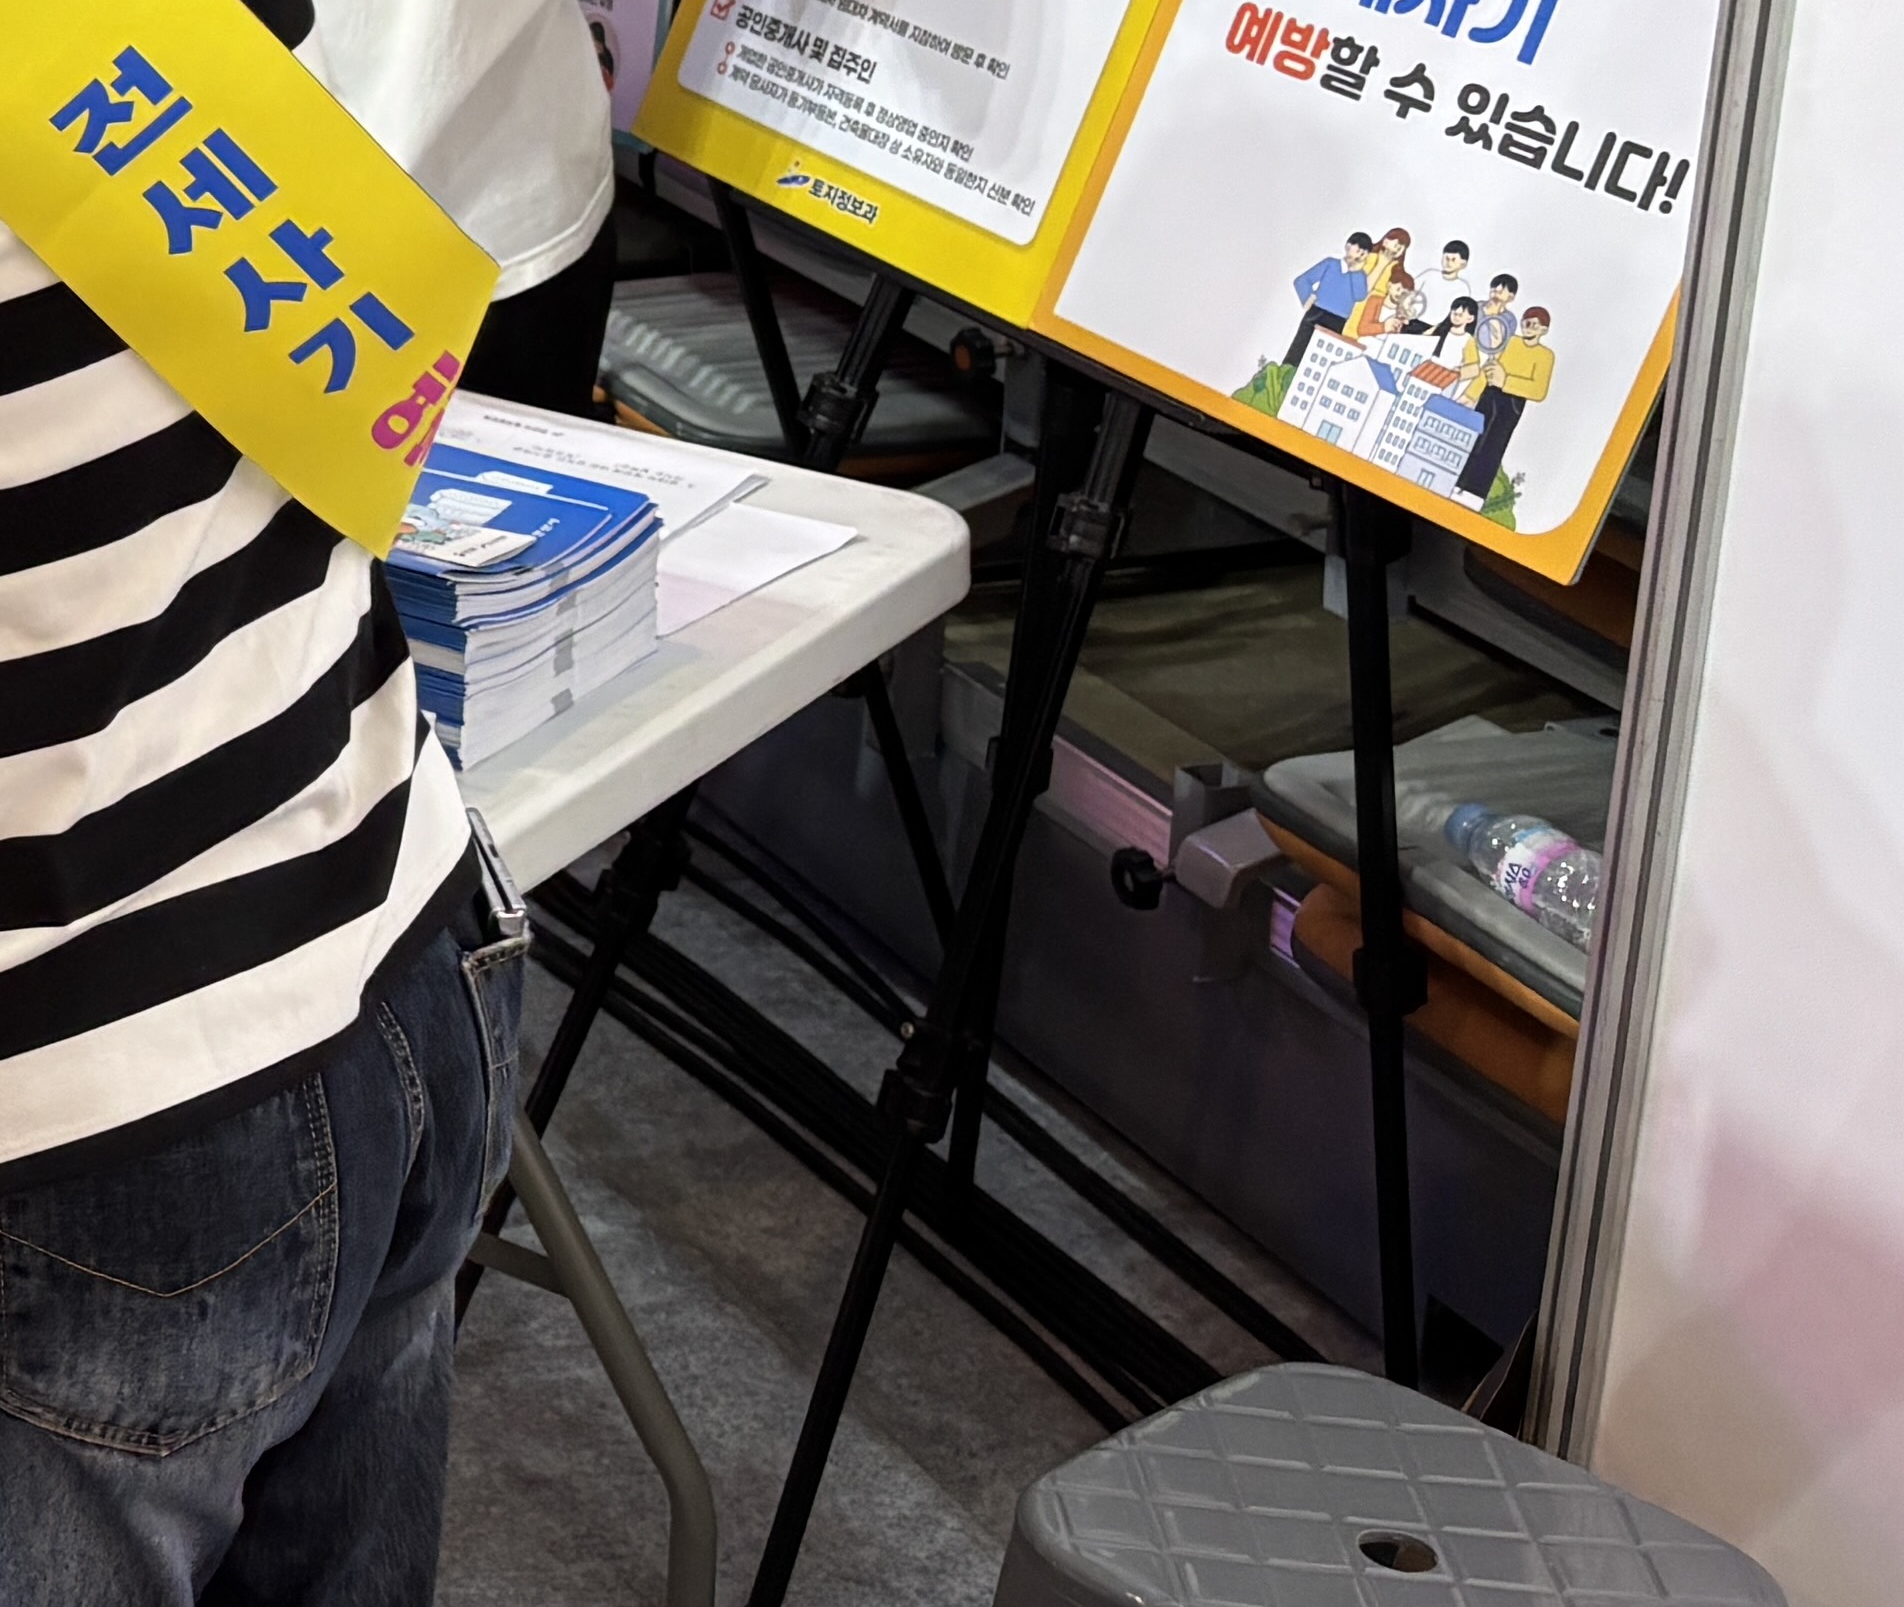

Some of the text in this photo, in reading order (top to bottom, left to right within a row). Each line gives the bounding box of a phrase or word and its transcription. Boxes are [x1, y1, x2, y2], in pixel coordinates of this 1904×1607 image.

[736, 5, 877, 84] 공인중개사 및 집주인
[987, 57, 1010, 80] 확인
[1224, 1, 1690, 215] 예방할 수 있습니다!
[917, 126, 950, 152] 중인지
[950, 139, 974, 162] 확인
[808, 178, 879, 224] 토지정보과
[943, 162, 988, 195] 동일한지
[987, 182, 1011, 205] 신분
[1011, 192, 1036, 217] 확인
[49, 44, 417, 395] 전세사기
